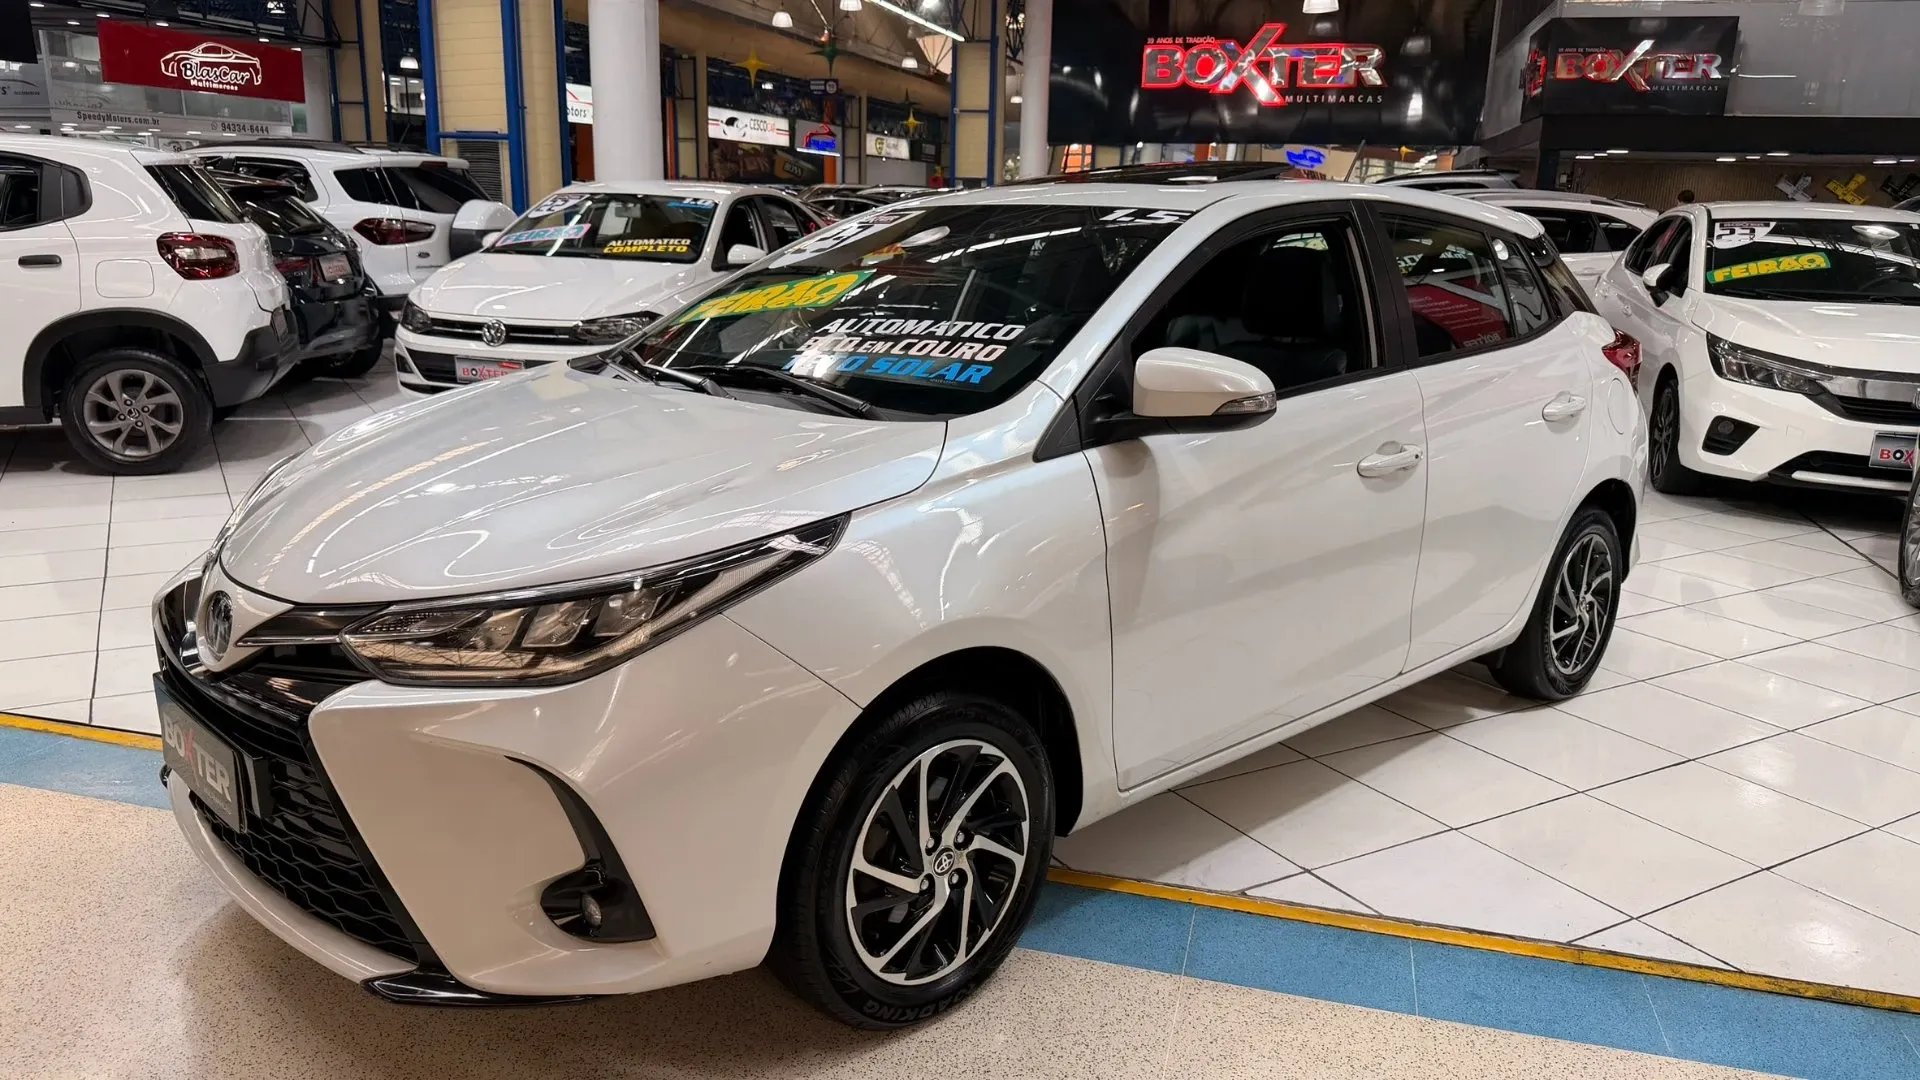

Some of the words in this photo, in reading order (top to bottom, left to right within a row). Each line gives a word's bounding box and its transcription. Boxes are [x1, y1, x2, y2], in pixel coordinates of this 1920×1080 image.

[180, 60, 251, 85] BlasCar
[1141, 23, 1388, 106] BOXTER
[1555, 39, 1722, 93] BOXTER
[190, 79, 238, 91] Multimarcas
[1651, 84, 1719, 92] MULTIMARCAS
[1285, 94, 1383, 104] MULTIMARCAS
[76, 111, 160, 126] SpeedyMotors.com.br
[1100, 208, 1192, 224] 1.5
[602, 245, 689, 254] COMPLETO
[868, 340, 892, 354] EM
[896, 338, 1008, 362] COURO
[867, 356, 994, 384] SOLAR
[163, 711, 232, 802] BOXTER
